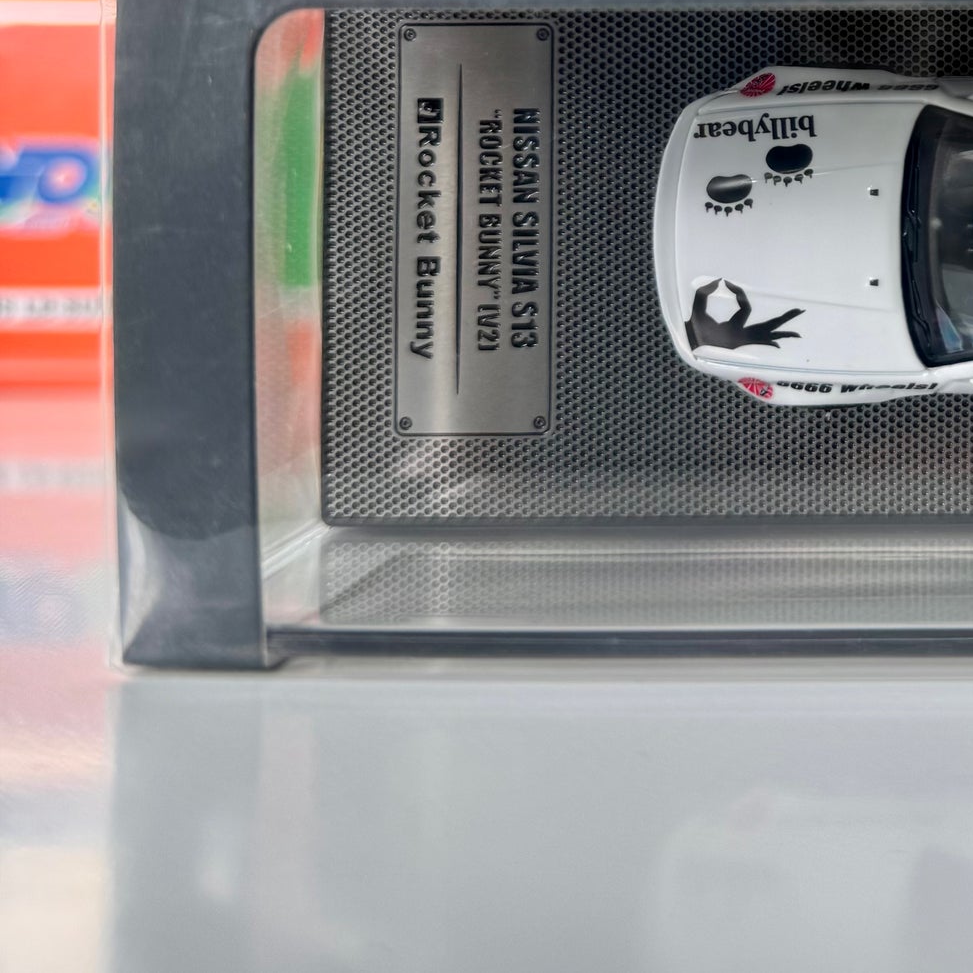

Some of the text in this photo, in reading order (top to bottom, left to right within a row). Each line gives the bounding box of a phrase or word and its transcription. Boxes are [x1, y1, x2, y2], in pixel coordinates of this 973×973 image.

[410, 125, 442, 360] Rocket Bunny
[510, 107, 541, 349] NISSAN SILVIA S13
[693, 112, 818, 142] billybear
